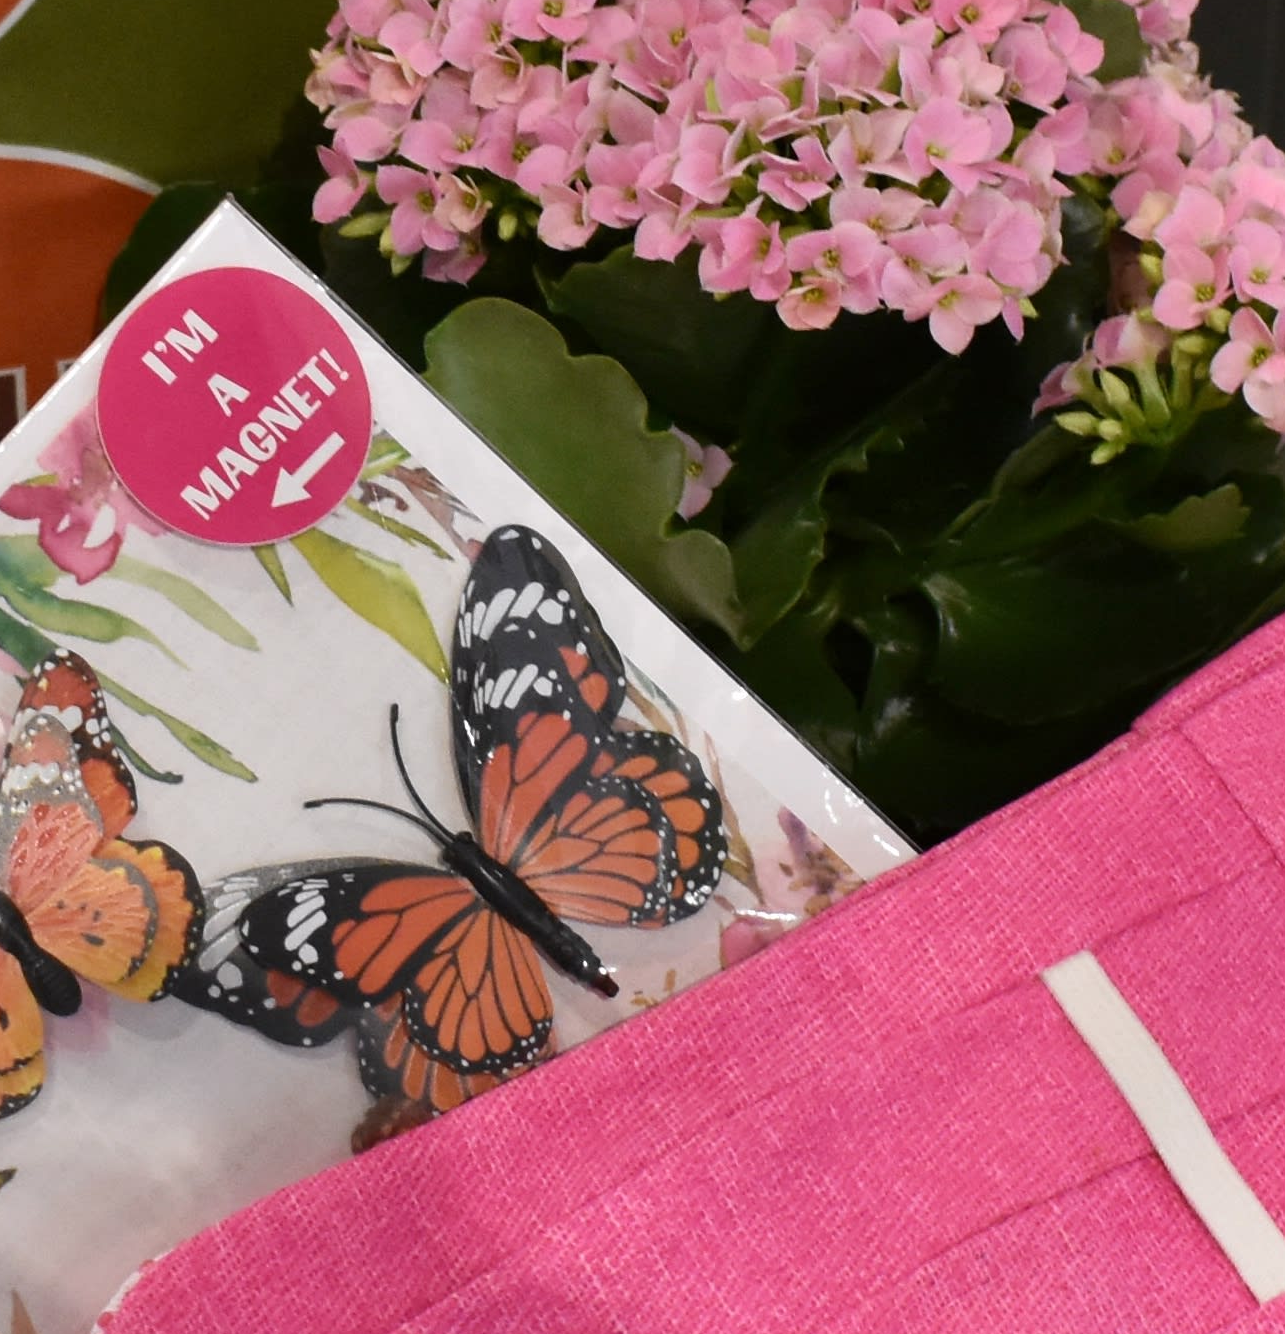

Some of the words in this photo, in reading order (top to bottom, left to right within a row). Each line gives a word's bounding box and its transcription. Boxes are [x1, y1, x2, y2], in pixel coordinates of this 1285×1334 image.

[141, 309, 219, 385] I'M
[206, 373, 250, 416] A
[180, 348, 349, 519] MAGNET!
